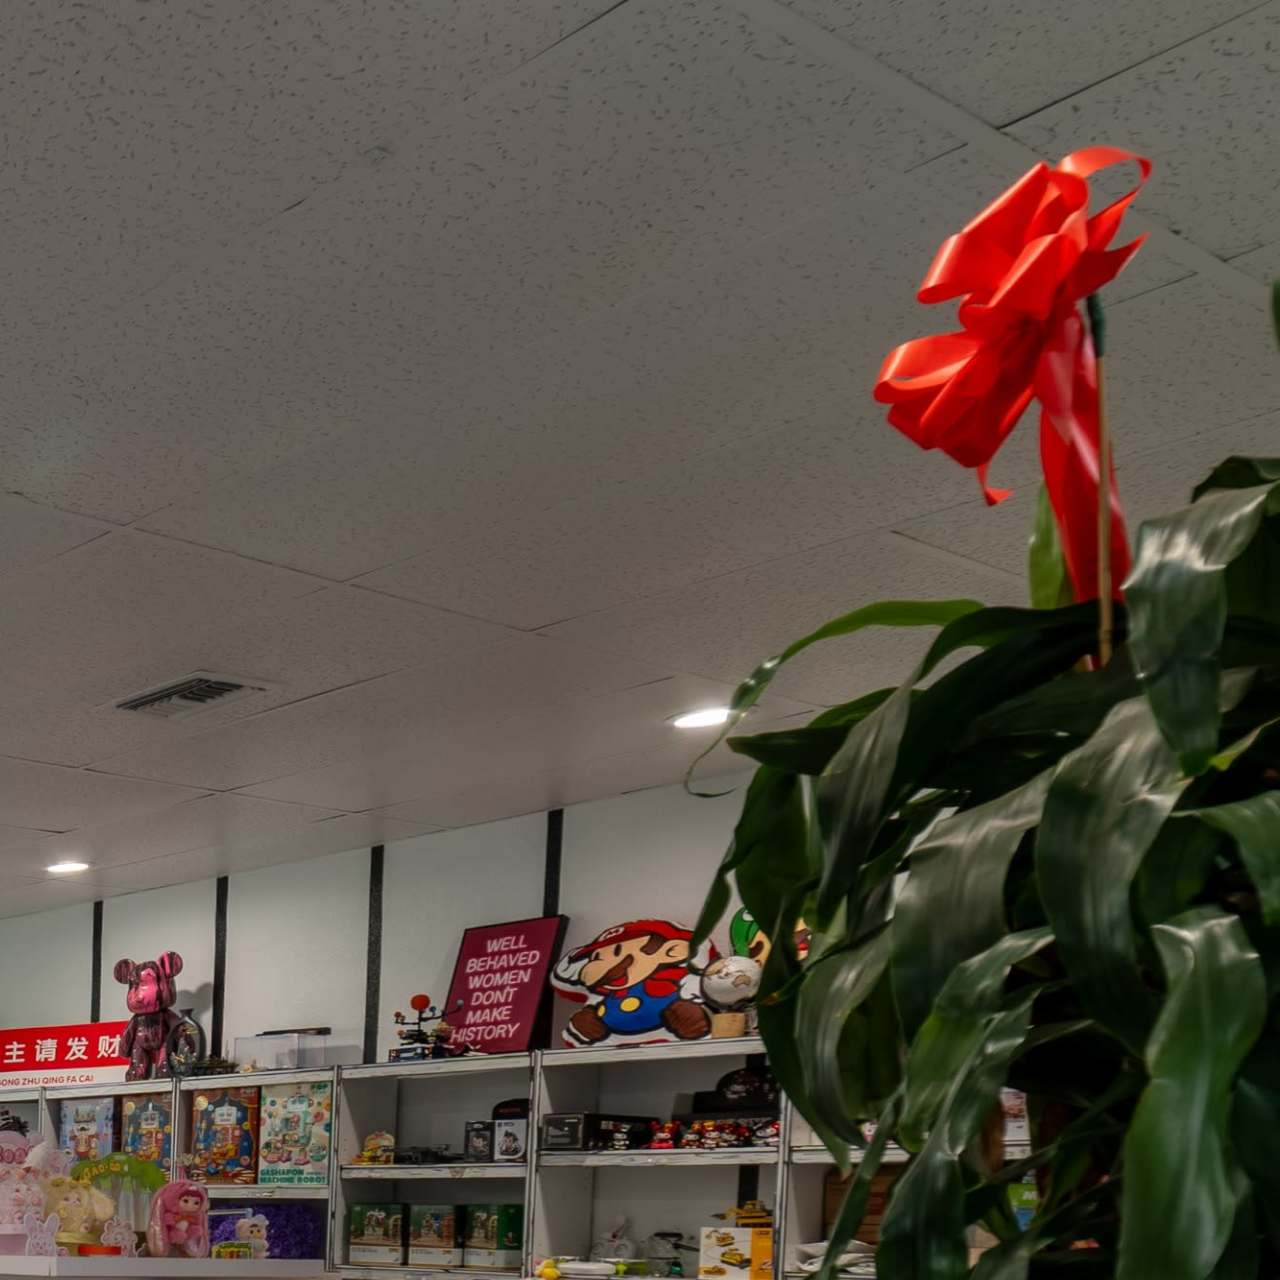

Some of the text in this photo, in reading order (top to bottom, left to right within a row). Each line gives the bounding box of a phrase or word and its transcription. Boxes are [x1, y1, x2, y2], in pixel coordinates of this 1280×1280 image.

[487, 934, 528, 953] WELL
[465, 950, 540, 973] BEHAVED
[468, 968, 532, 989] WOMEN
[465, 1006, 513, 1025] MAKE
[449, 1022, 521, 1043] HISTORY
[22, 1076, 41, 1086] ZHU
[42, 1075, 65, 1085] QING
[67, 1075, 78, 1083] FA
[296, 1176, 327, 1184] ROBOT
